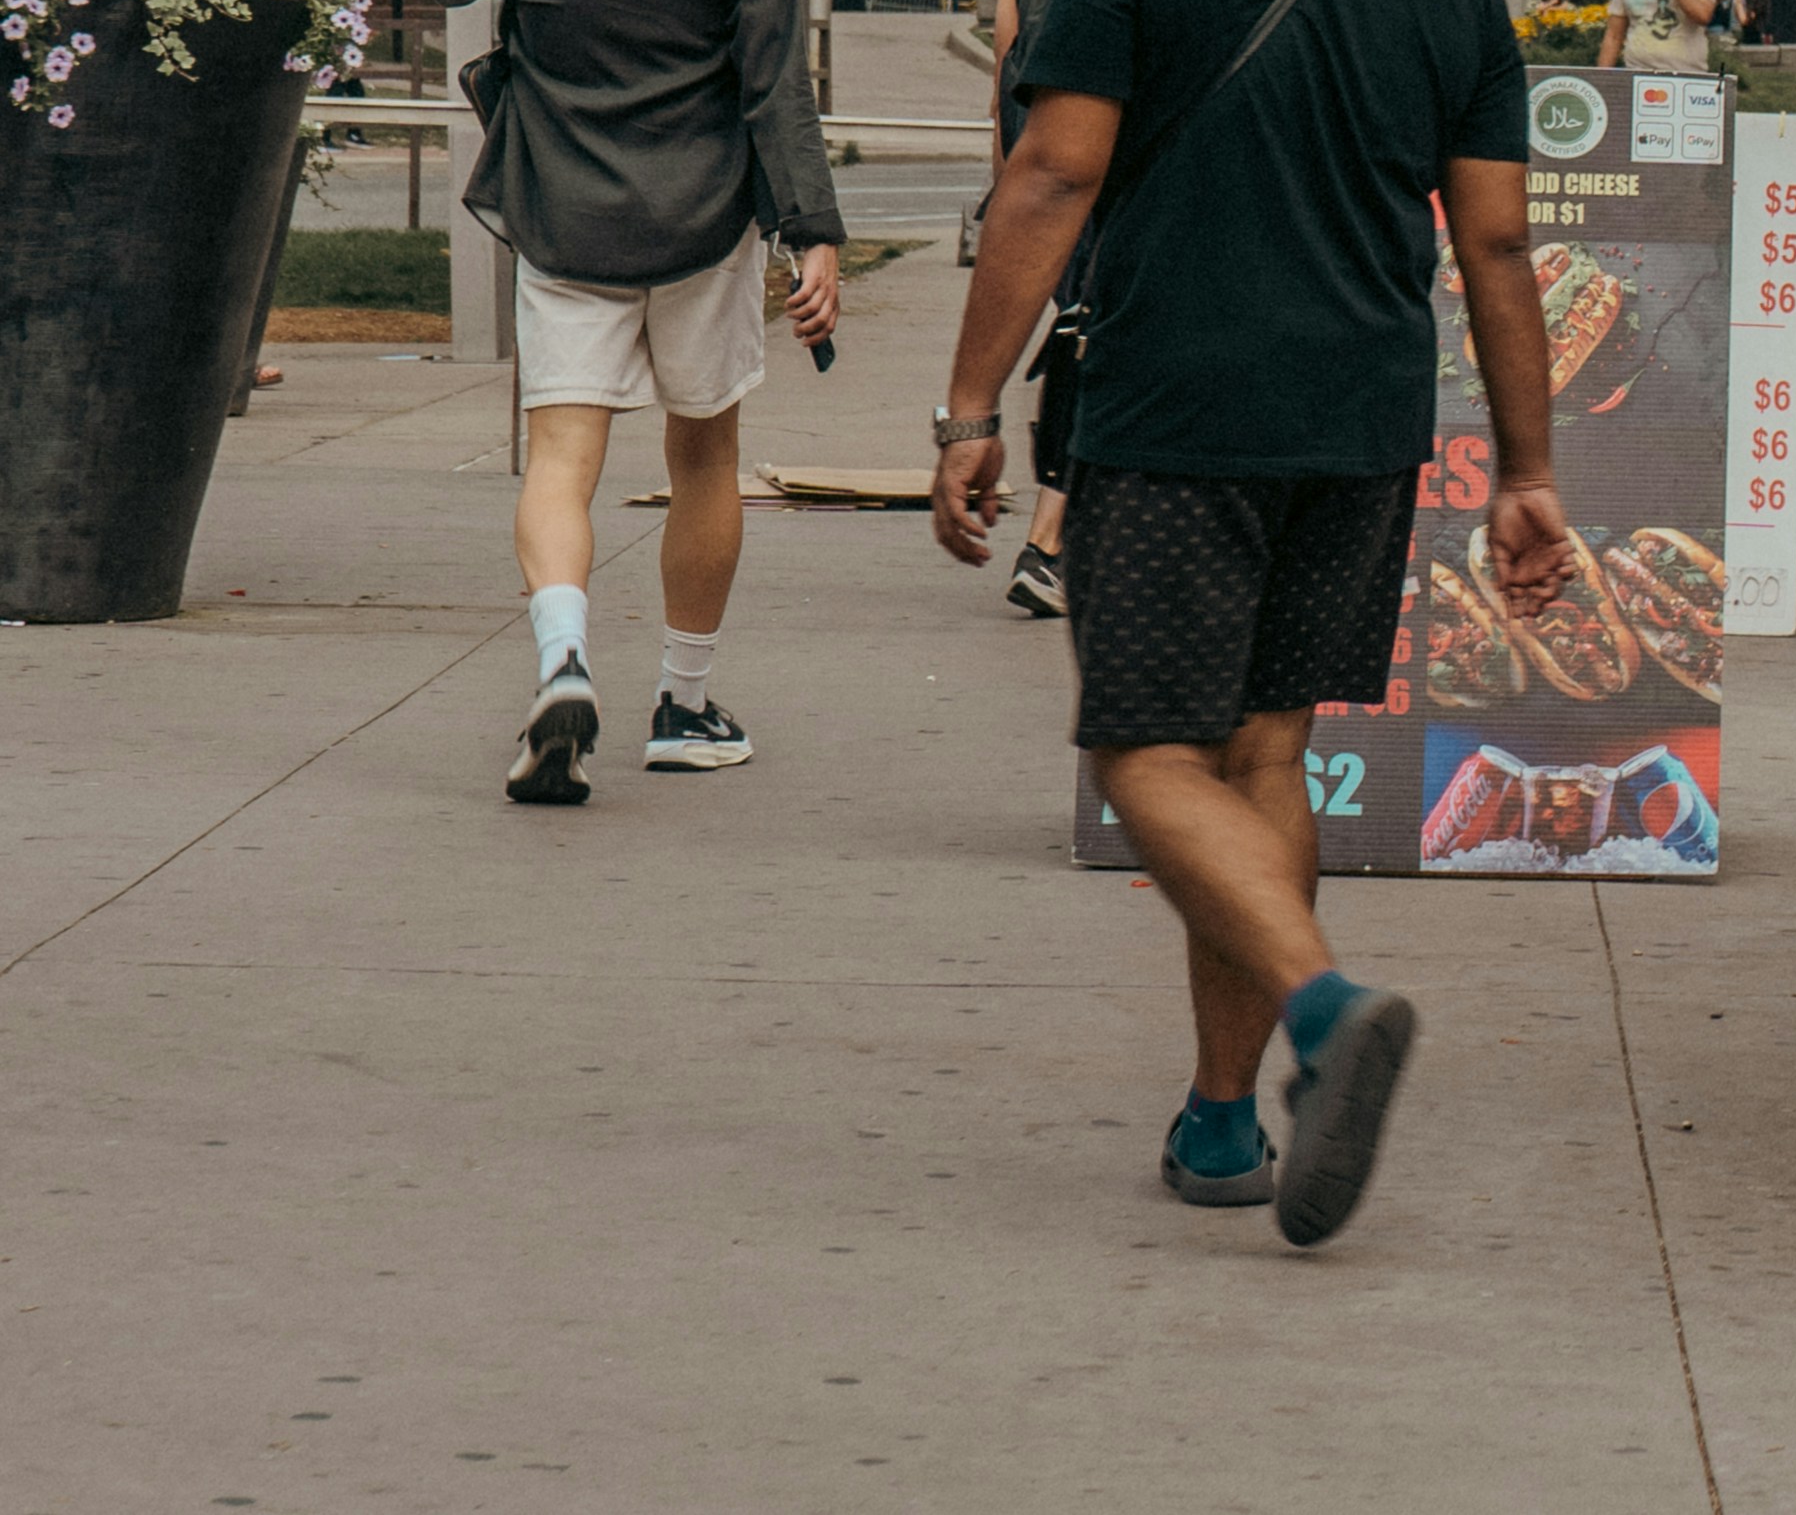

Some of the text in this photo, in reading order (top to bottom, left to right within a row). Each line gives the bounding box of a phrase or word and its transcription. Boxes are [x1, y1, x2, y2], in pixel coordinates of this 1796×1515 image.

[1689, 95, 1716, 106] VISA
[1541, 142, 1585, 154] CERTIFIED
[1650, 134, 1671, 148] Pay
[1564, 173, 1640, 196] CHEESE
[1560, 201, 1585, 225] $1
[1759, 280, 1796, 315] $6
[1755, 378, 1791, 414] $6
[1752, 428, 1788, 463] $6
[1749, 477, 1786, 512] $6
